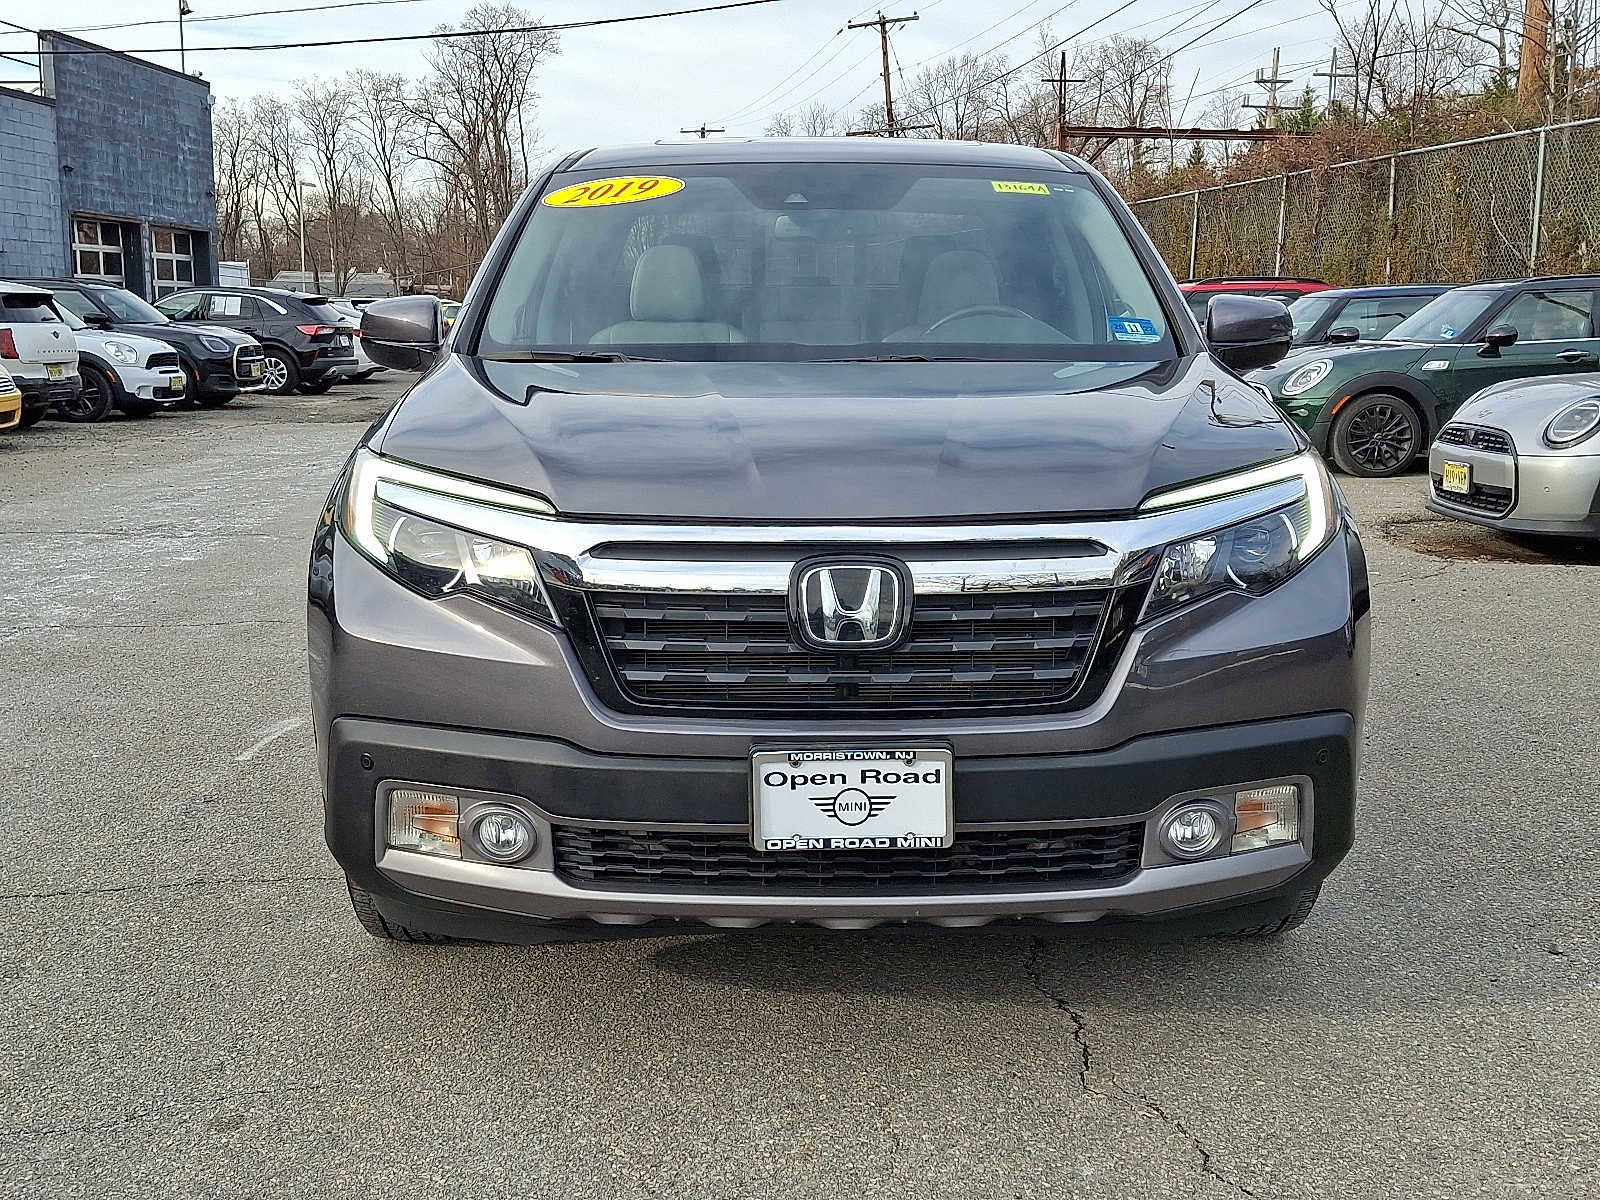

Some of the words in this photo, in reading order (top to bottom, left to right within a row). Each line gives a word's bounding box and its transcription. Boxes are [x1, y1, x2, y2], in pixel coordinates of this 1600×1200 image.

[563, 180, 660, 204] 2019
[1127, 324, 1140, 332] 11
[791, 752, 890, 761] MORRISTOWN,
[764, 771, 847, 790] Open
[860, 769, 941, 785] Road
[838, 801, 867, 812] MINI
[767, 839, 824, 850] OPEN
[831, 838, 890, 849] ROAD
[897, 838, 942, 849] MINI
